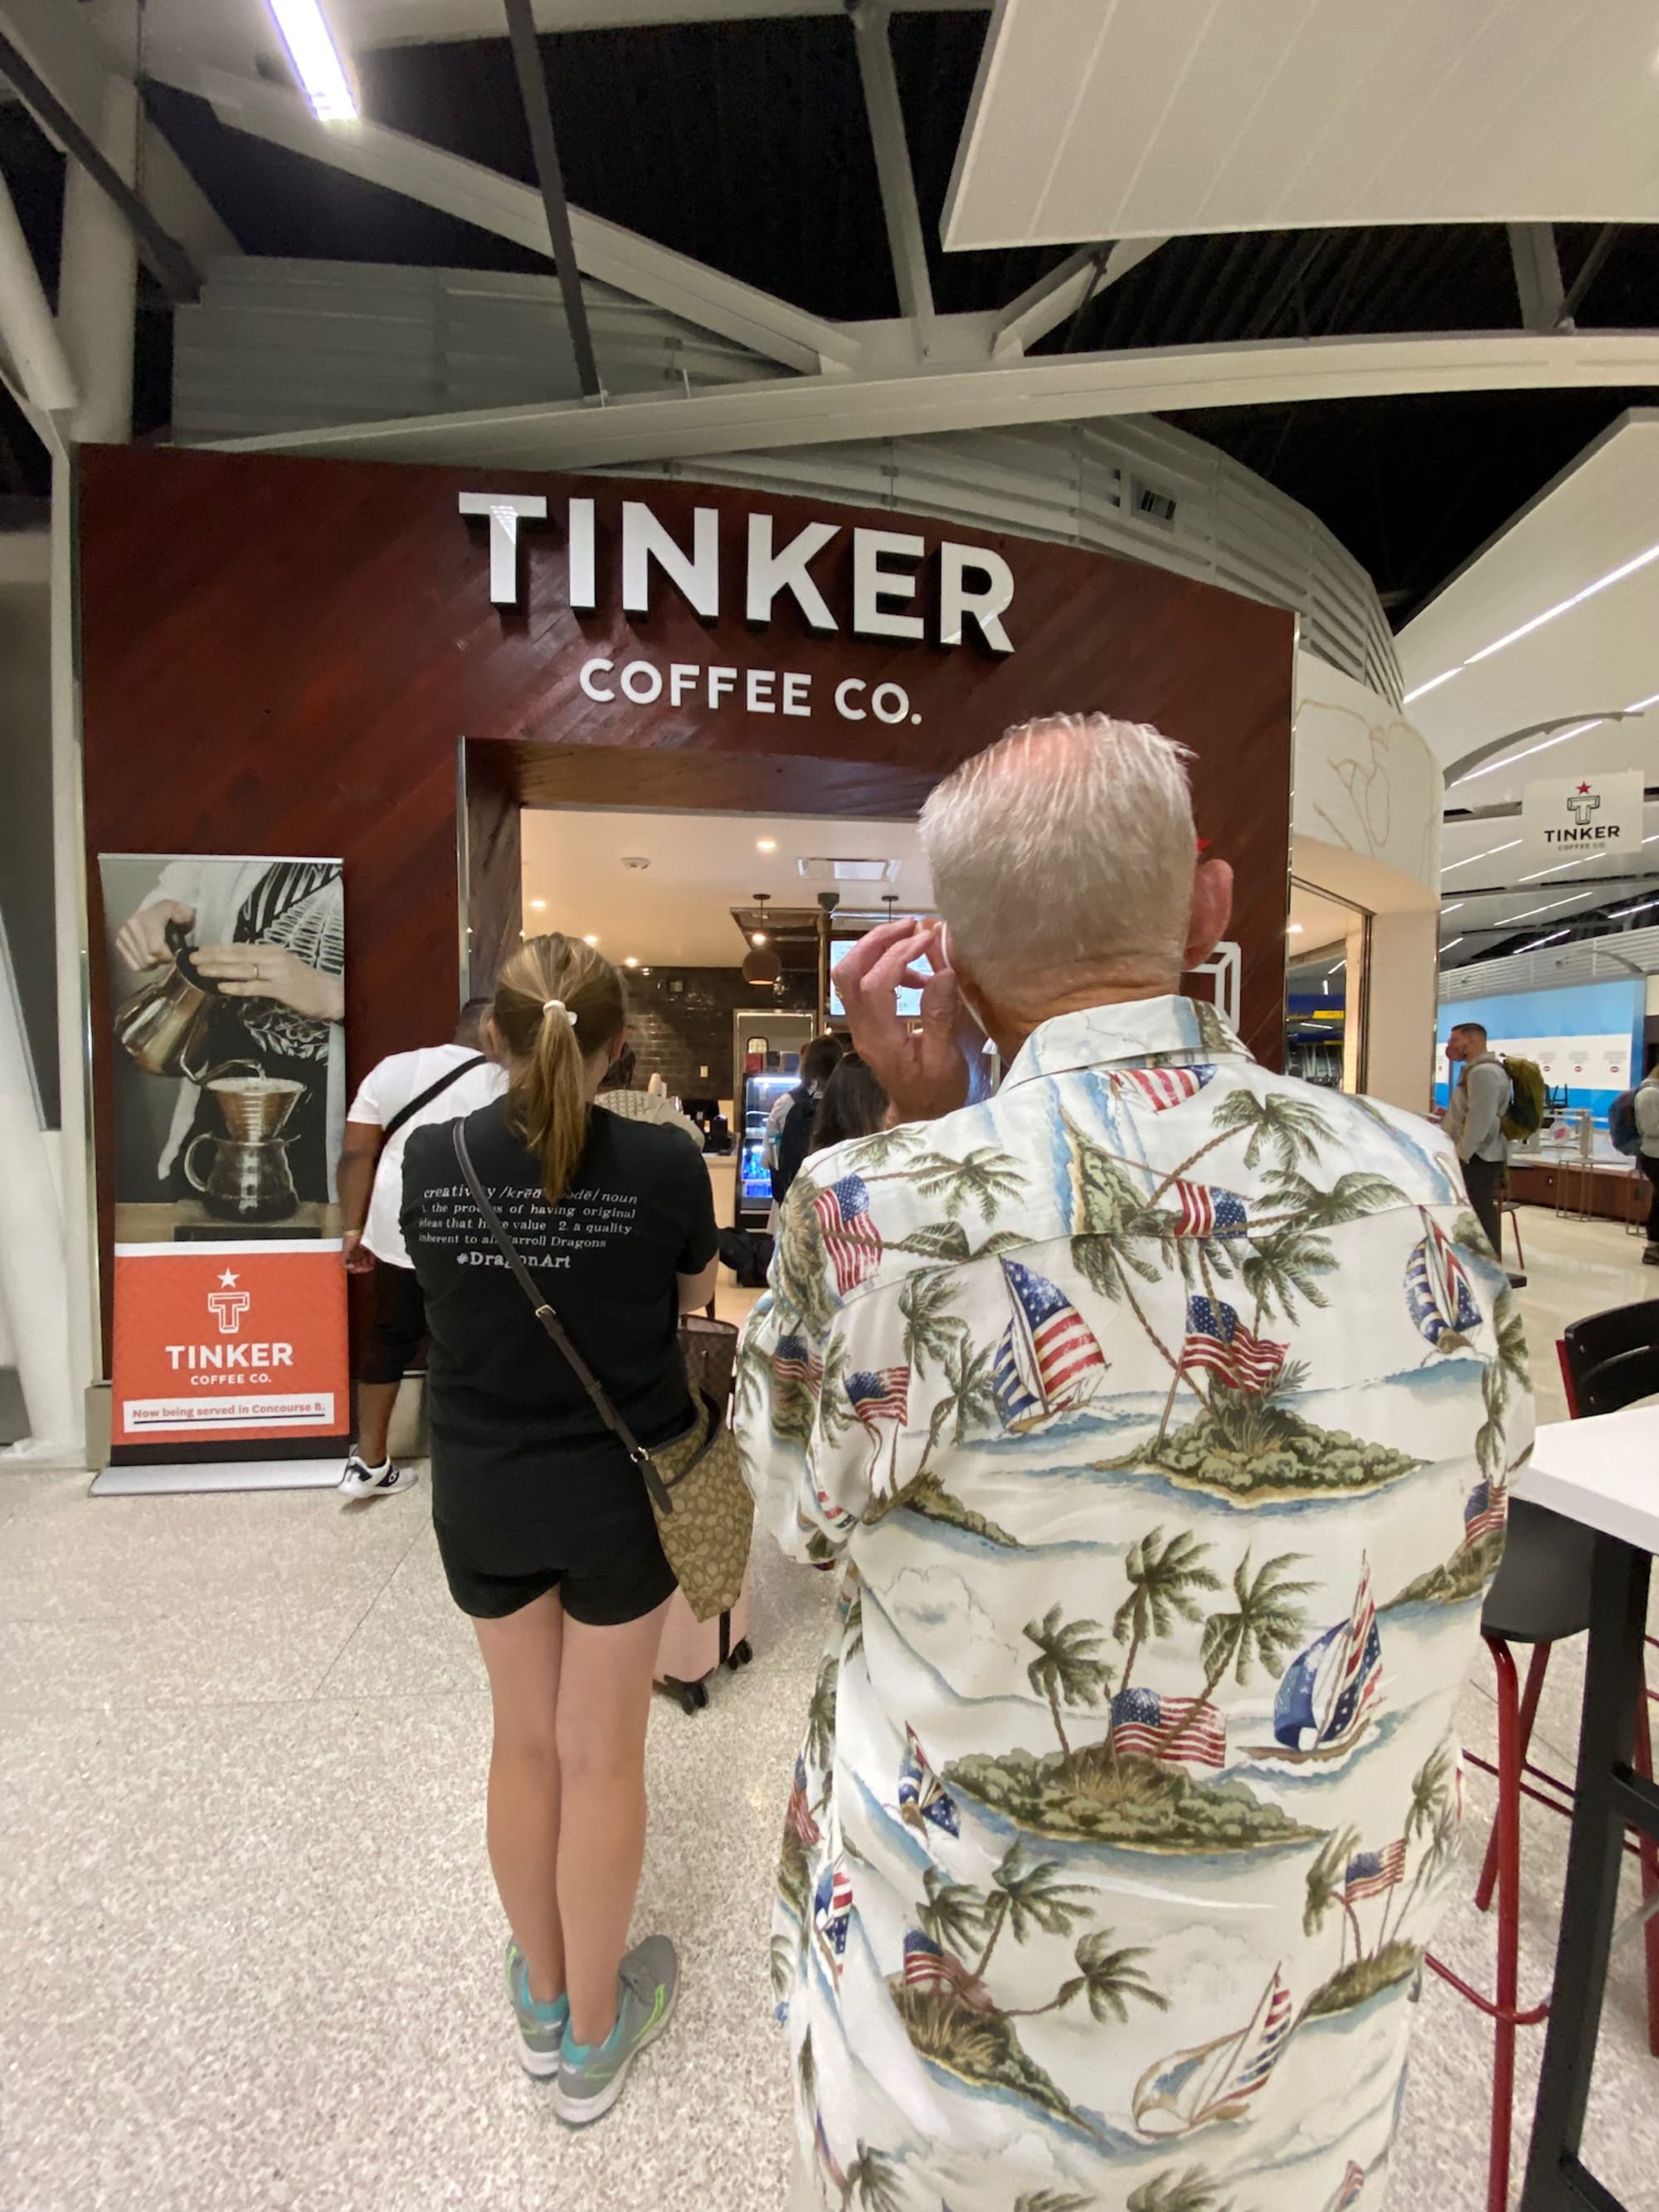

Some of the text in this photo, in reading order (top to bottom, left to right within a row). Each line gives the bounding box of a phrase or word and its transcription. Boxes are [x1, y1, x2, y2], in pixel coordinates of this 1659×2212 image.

[459, 491, 1015, 653] TINKER
[579, 658, 922, 726] COFFEE CO.
[1544, 826, 1619, 843] TINKER
[1558, 842, 1590, 851] COFFEE
[424, 1185, 496, 1200] creativy
[601, 1192, 638, 1204] noun
[431, 1202, 449, 1213] the
[509, 1204, 524, 1214] of
[531, 1203, 577, 1217] having
[582, 1206, 636, 1219] original
[418, 1217, 443, 1228] ideas
[446, 1217, 473, 1228] that
[478, 1217, 508, 1229] he
[513, 1219, 547, 1230] value
[573, 1222, 581, 1231] a
[586, 1222, 633, 1235] quality
[418, 1232, 606, 1249] inherent to al arroll Dragons
[165, 1342, 294, 1370] TINKER
[191, 1373, 272, 1386] COFFEE CO.
[133, 1402, 326, 1419] Now being served in Concourse B.
